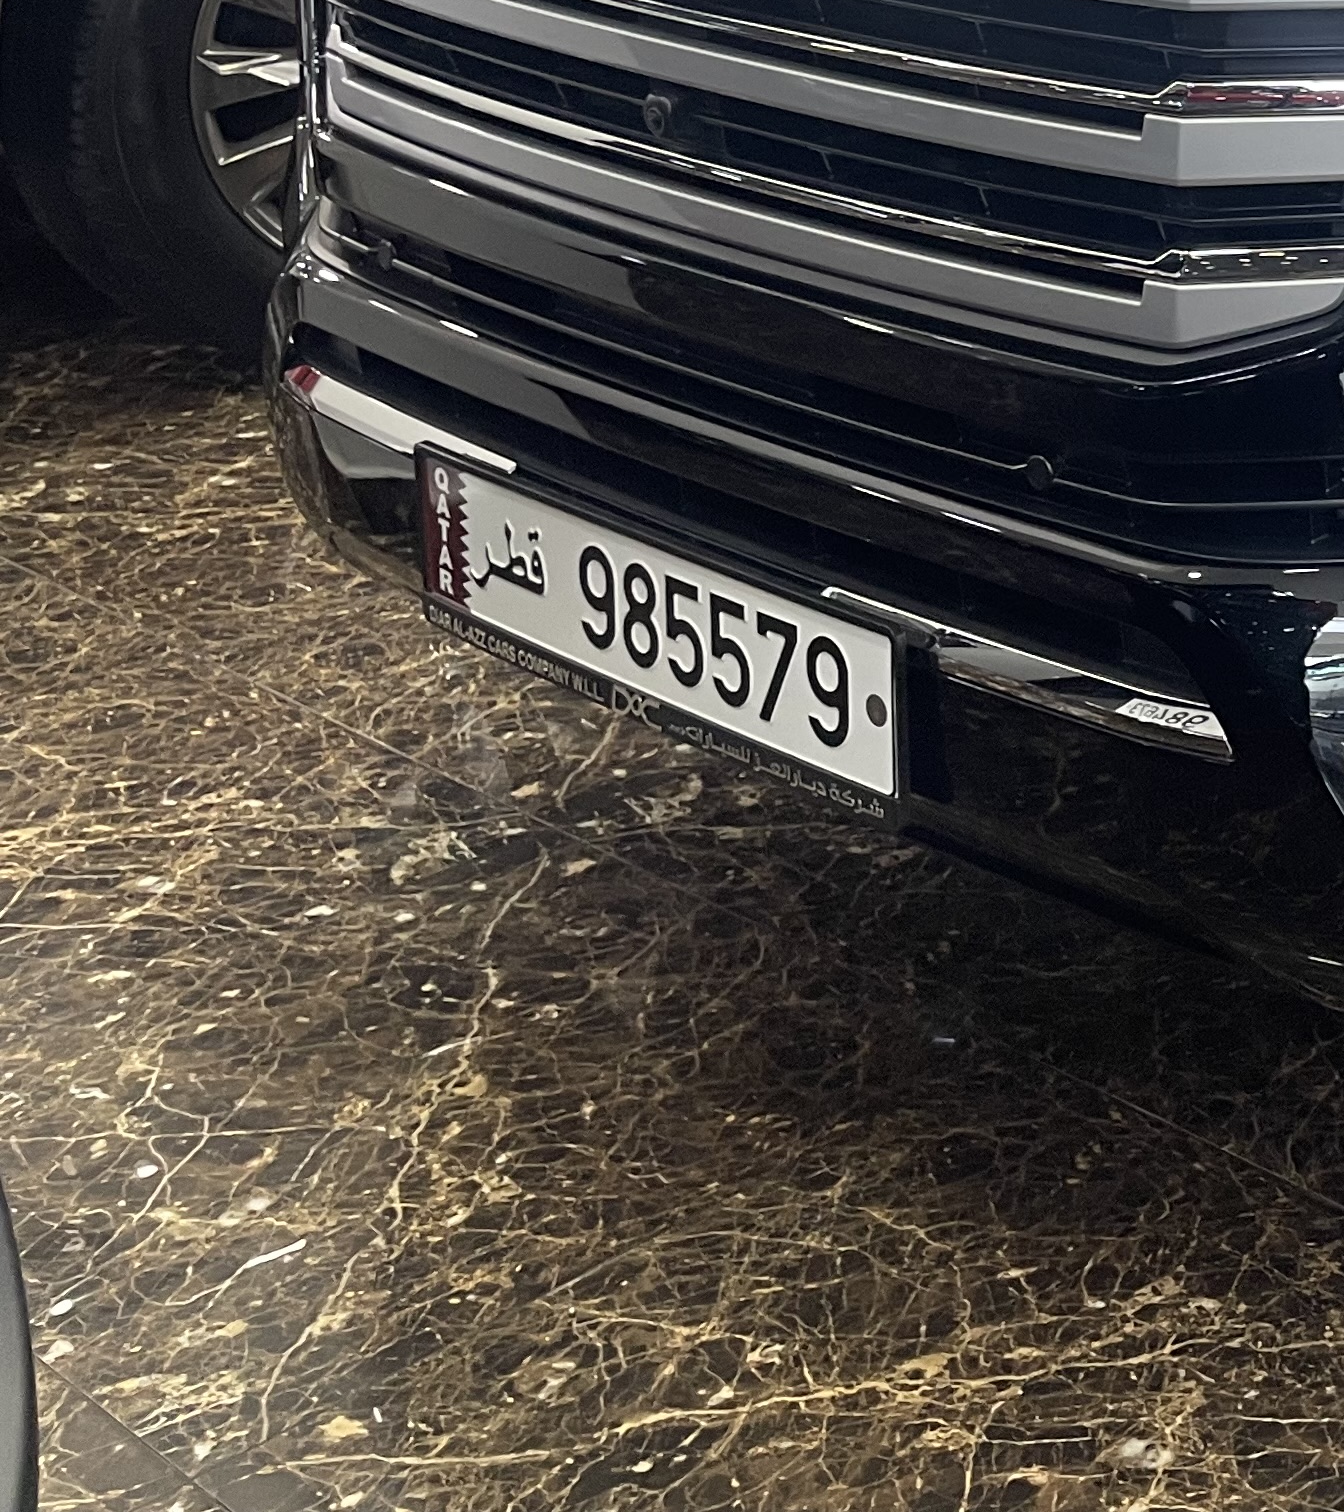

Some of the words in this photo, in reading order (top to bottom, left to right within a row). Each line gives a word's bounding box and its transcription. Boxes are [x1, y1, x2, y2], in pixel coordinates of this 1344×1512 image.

[434, 466, 454, 595] QATAR
[470, 519, 546, 596] قطر
[488, 635, 516, 663] CARS
[517, 649, 570, 686] COMPANY
[579, 545, 849, 748] 985579
[829, 783, 884, 818] شركة
